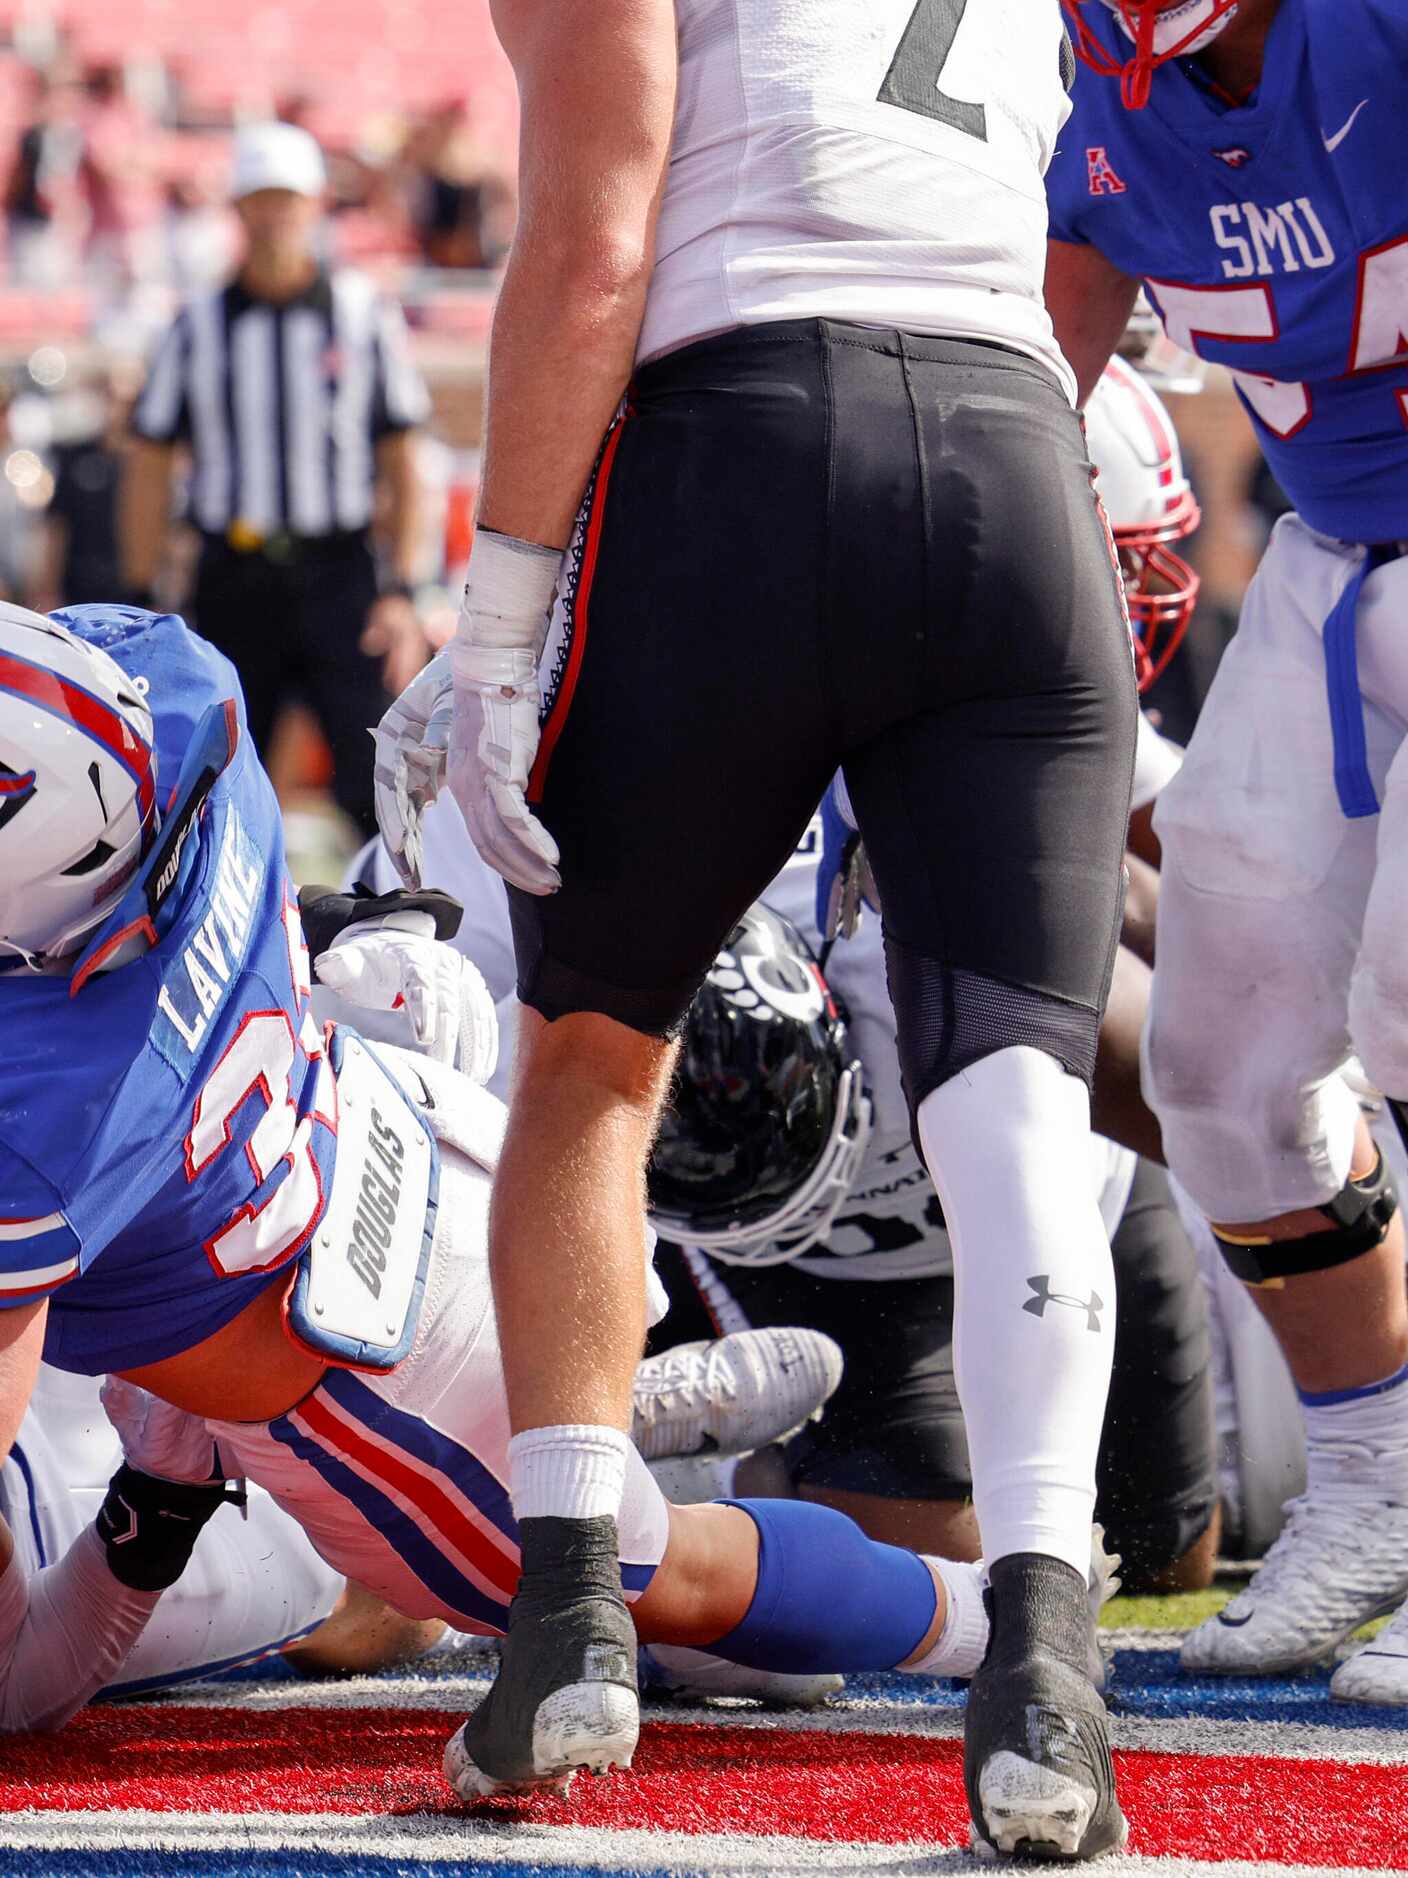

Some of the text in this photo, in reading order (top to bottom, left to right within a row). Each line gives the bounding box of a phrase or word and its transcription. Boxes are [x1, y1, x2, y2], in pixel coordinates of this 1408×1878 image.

[1208, 197, 1336, 279] SMU
[158, 798, 260, 1053] LAVINE
[346, 1106, 405, 1301] DOUGLAS
